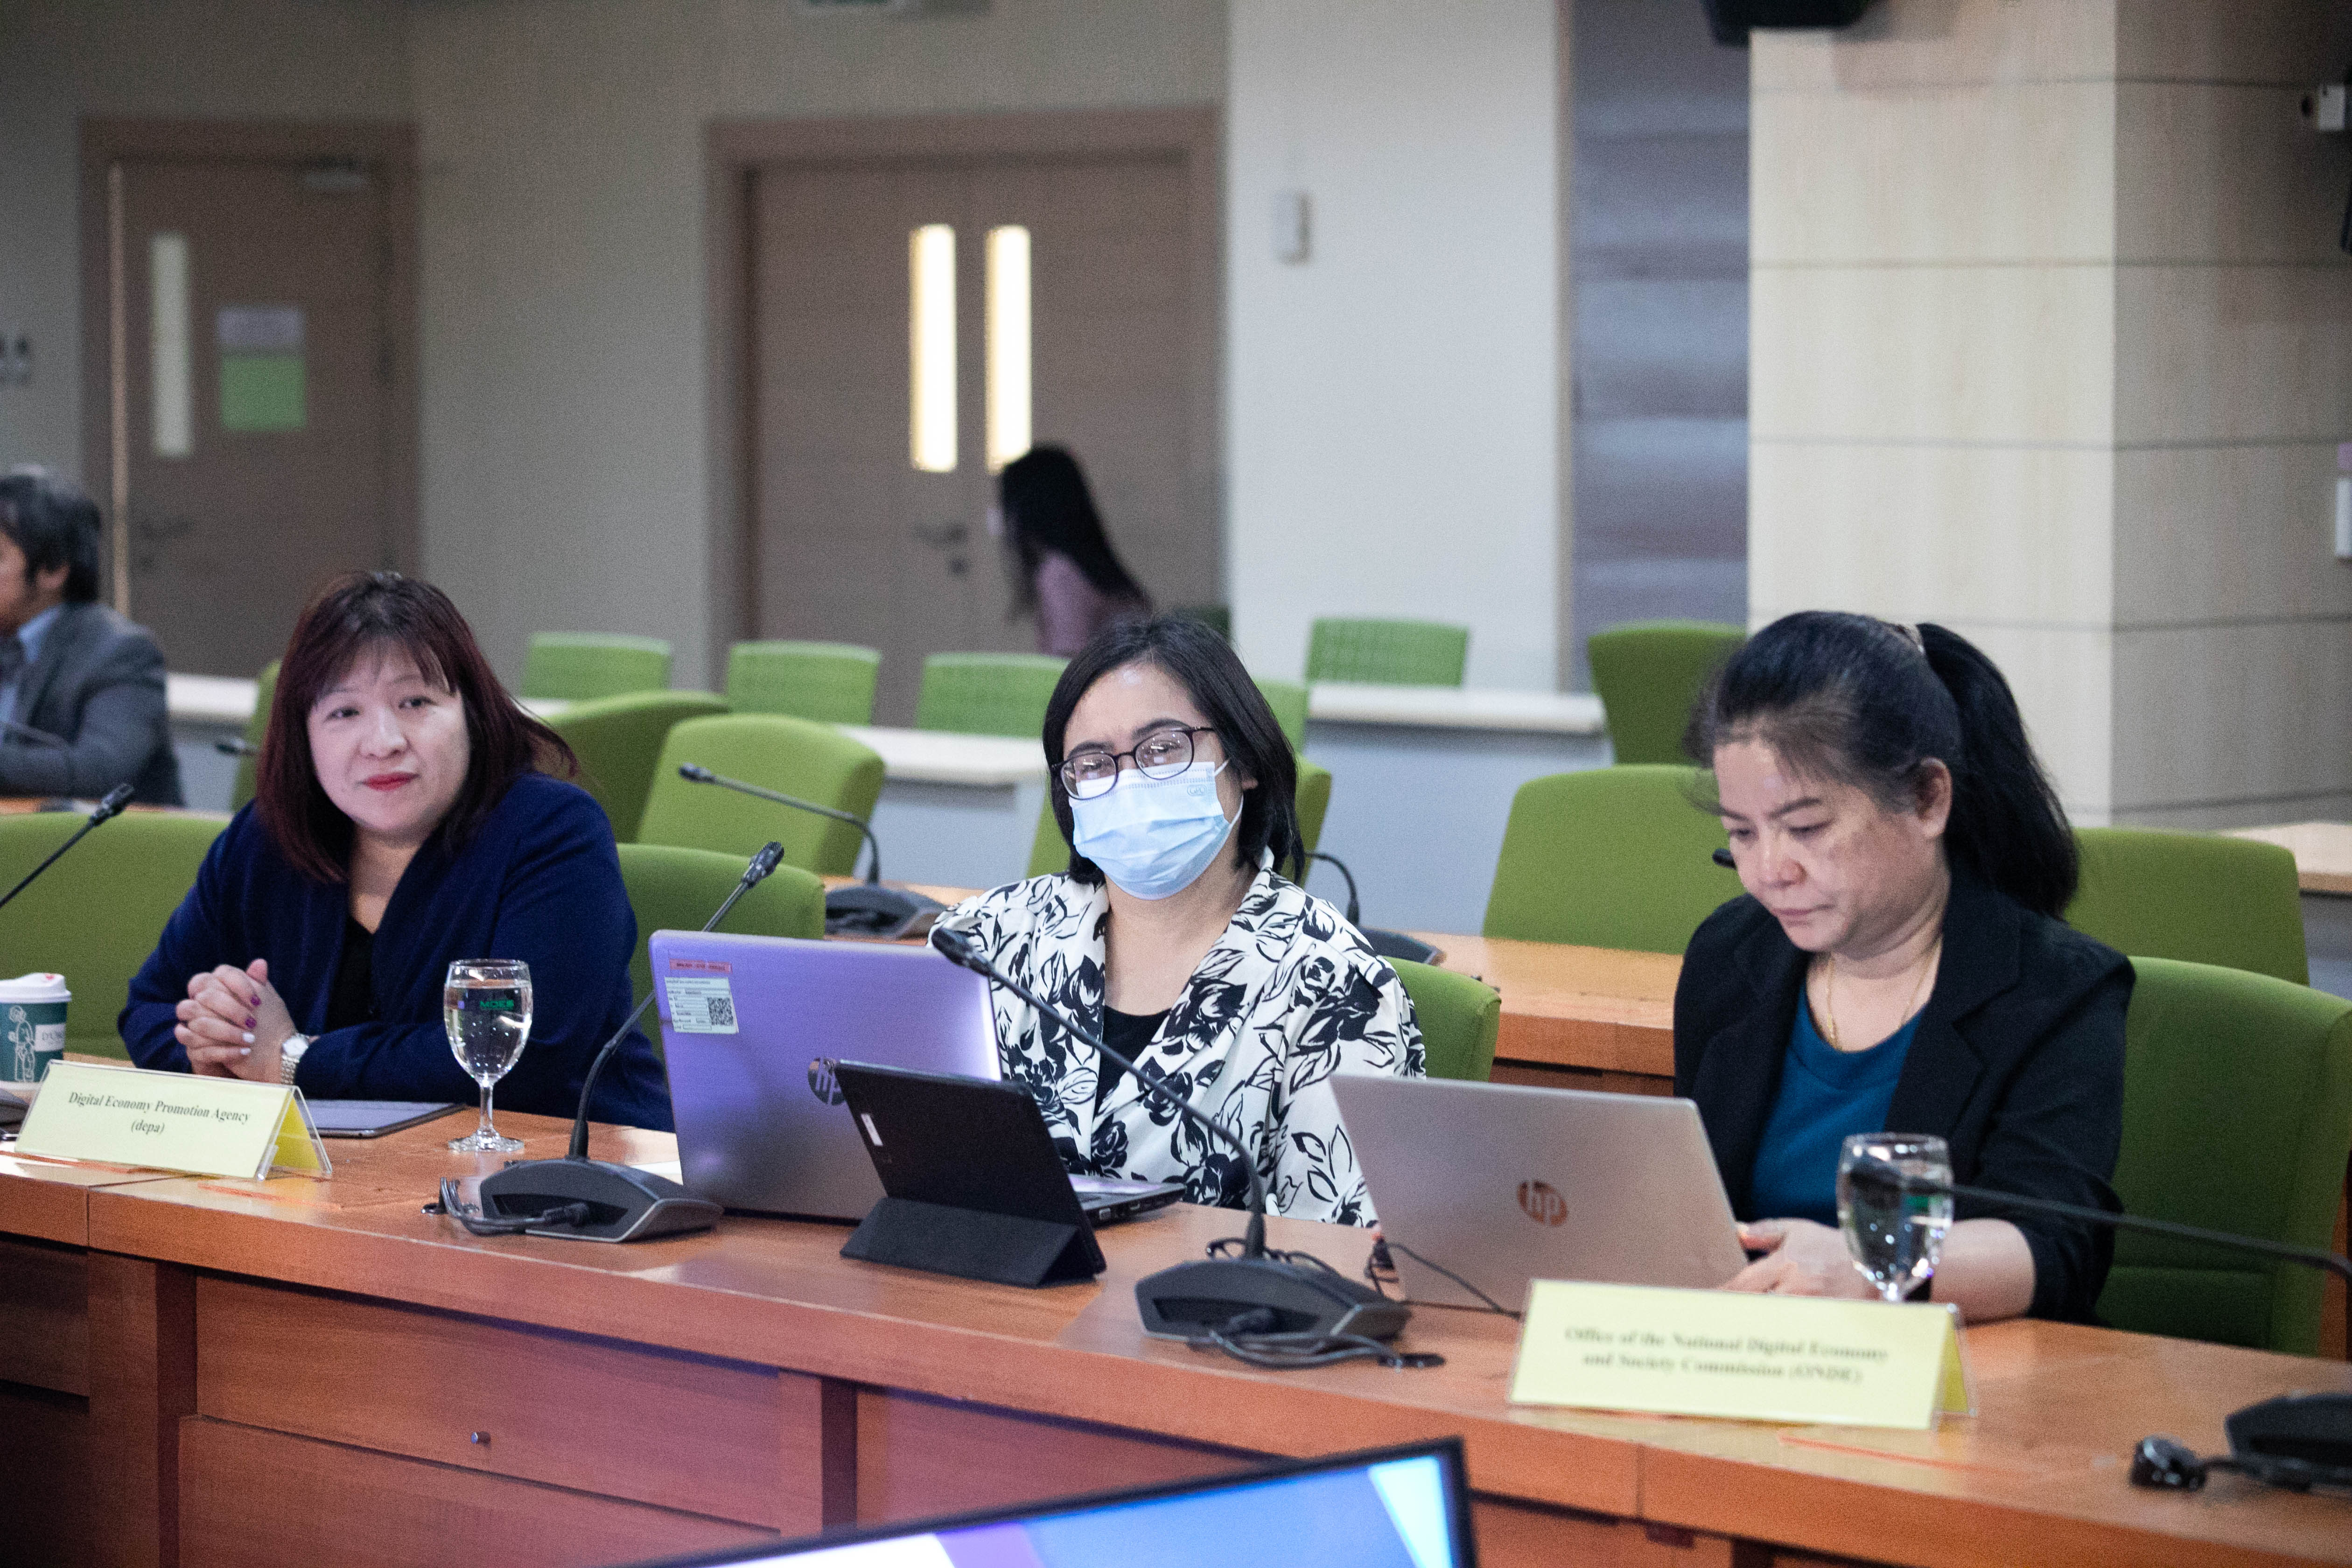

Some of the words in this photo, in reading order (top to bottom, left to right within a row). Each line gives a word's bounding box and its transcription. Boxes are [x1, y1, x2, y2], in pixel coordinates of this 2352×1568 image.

[69, 1092, 104, 1107] Digital
[105, 1095, 151, 1113] Economy
[154, 1100, 210, 1117] Promotion
[211, 1108, 250, 1125] Agency
[131, 1119, 165, 1135] (depa)
[1565, 1328, 1614, 1343] Office
[1618, 1329, 1639, 1344] of
[1641, 1331, 1665, 1347] the
[1673, 1333, 1743, 1351] National
[1746, 1336, 1804, 1356] Digital
[1809, 1339, 1888, 1364] Economy
[1584, 1352, 1614, 1366] and
[1618, 1354, 1675, 1373] Society
[1681, 1358, 1783, 1377] Commission
